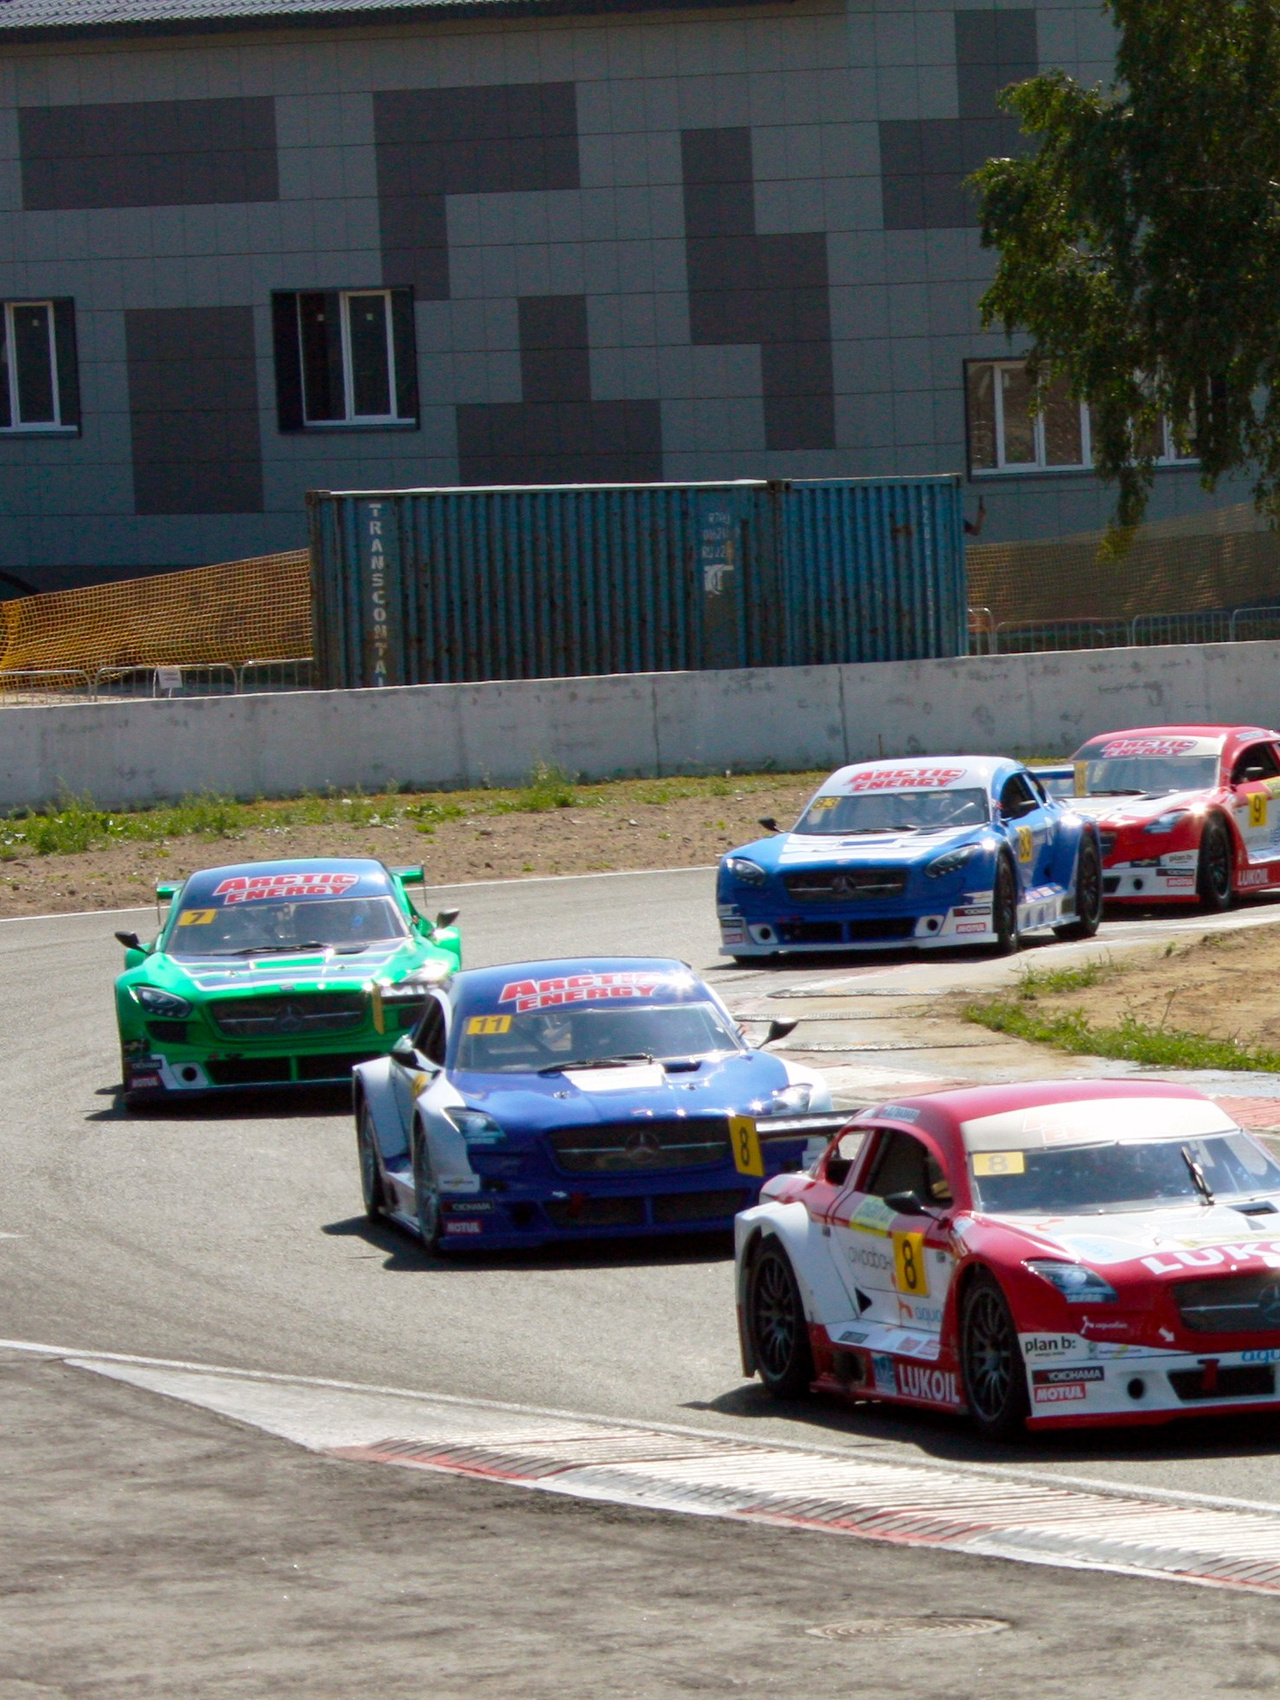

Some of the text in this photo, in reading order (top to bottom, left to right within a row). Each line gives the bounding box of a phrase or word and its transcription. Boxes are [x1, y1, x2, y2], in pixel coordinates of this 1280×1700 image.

[1104, 739, 1195, 752] ARCTIC
[848, 769, 964, 784] ARCTIC
[852, 778, 954, 792] ENERGY
[1254, 796, 1261, 824] 9
[213, 874, 358, 895] ARCTIC
[1237, 868, 1268, 886] LUKOIL
[225, 885, 351, 904] ENERGY
[189, 912, 208, 924] 7
[517, 985, 658, 1012] ENERGY
[475, 1017, 502, 1033] 11
[740, 1127, 749, 1166] 8
[986, 1155, 1009, 1173] 8
[446, 1221, 481, 1234] MOTUL
[902, 1240, 918, 1289] 8
[1025, 1336, 1076, 1354] plan b:
[1047, 1368, 1101, 1381] YOKOHAMA
[899, 1364, 960, 1404] LUKOIL
[1036, 1386, 1083, 1401] MOTUL
